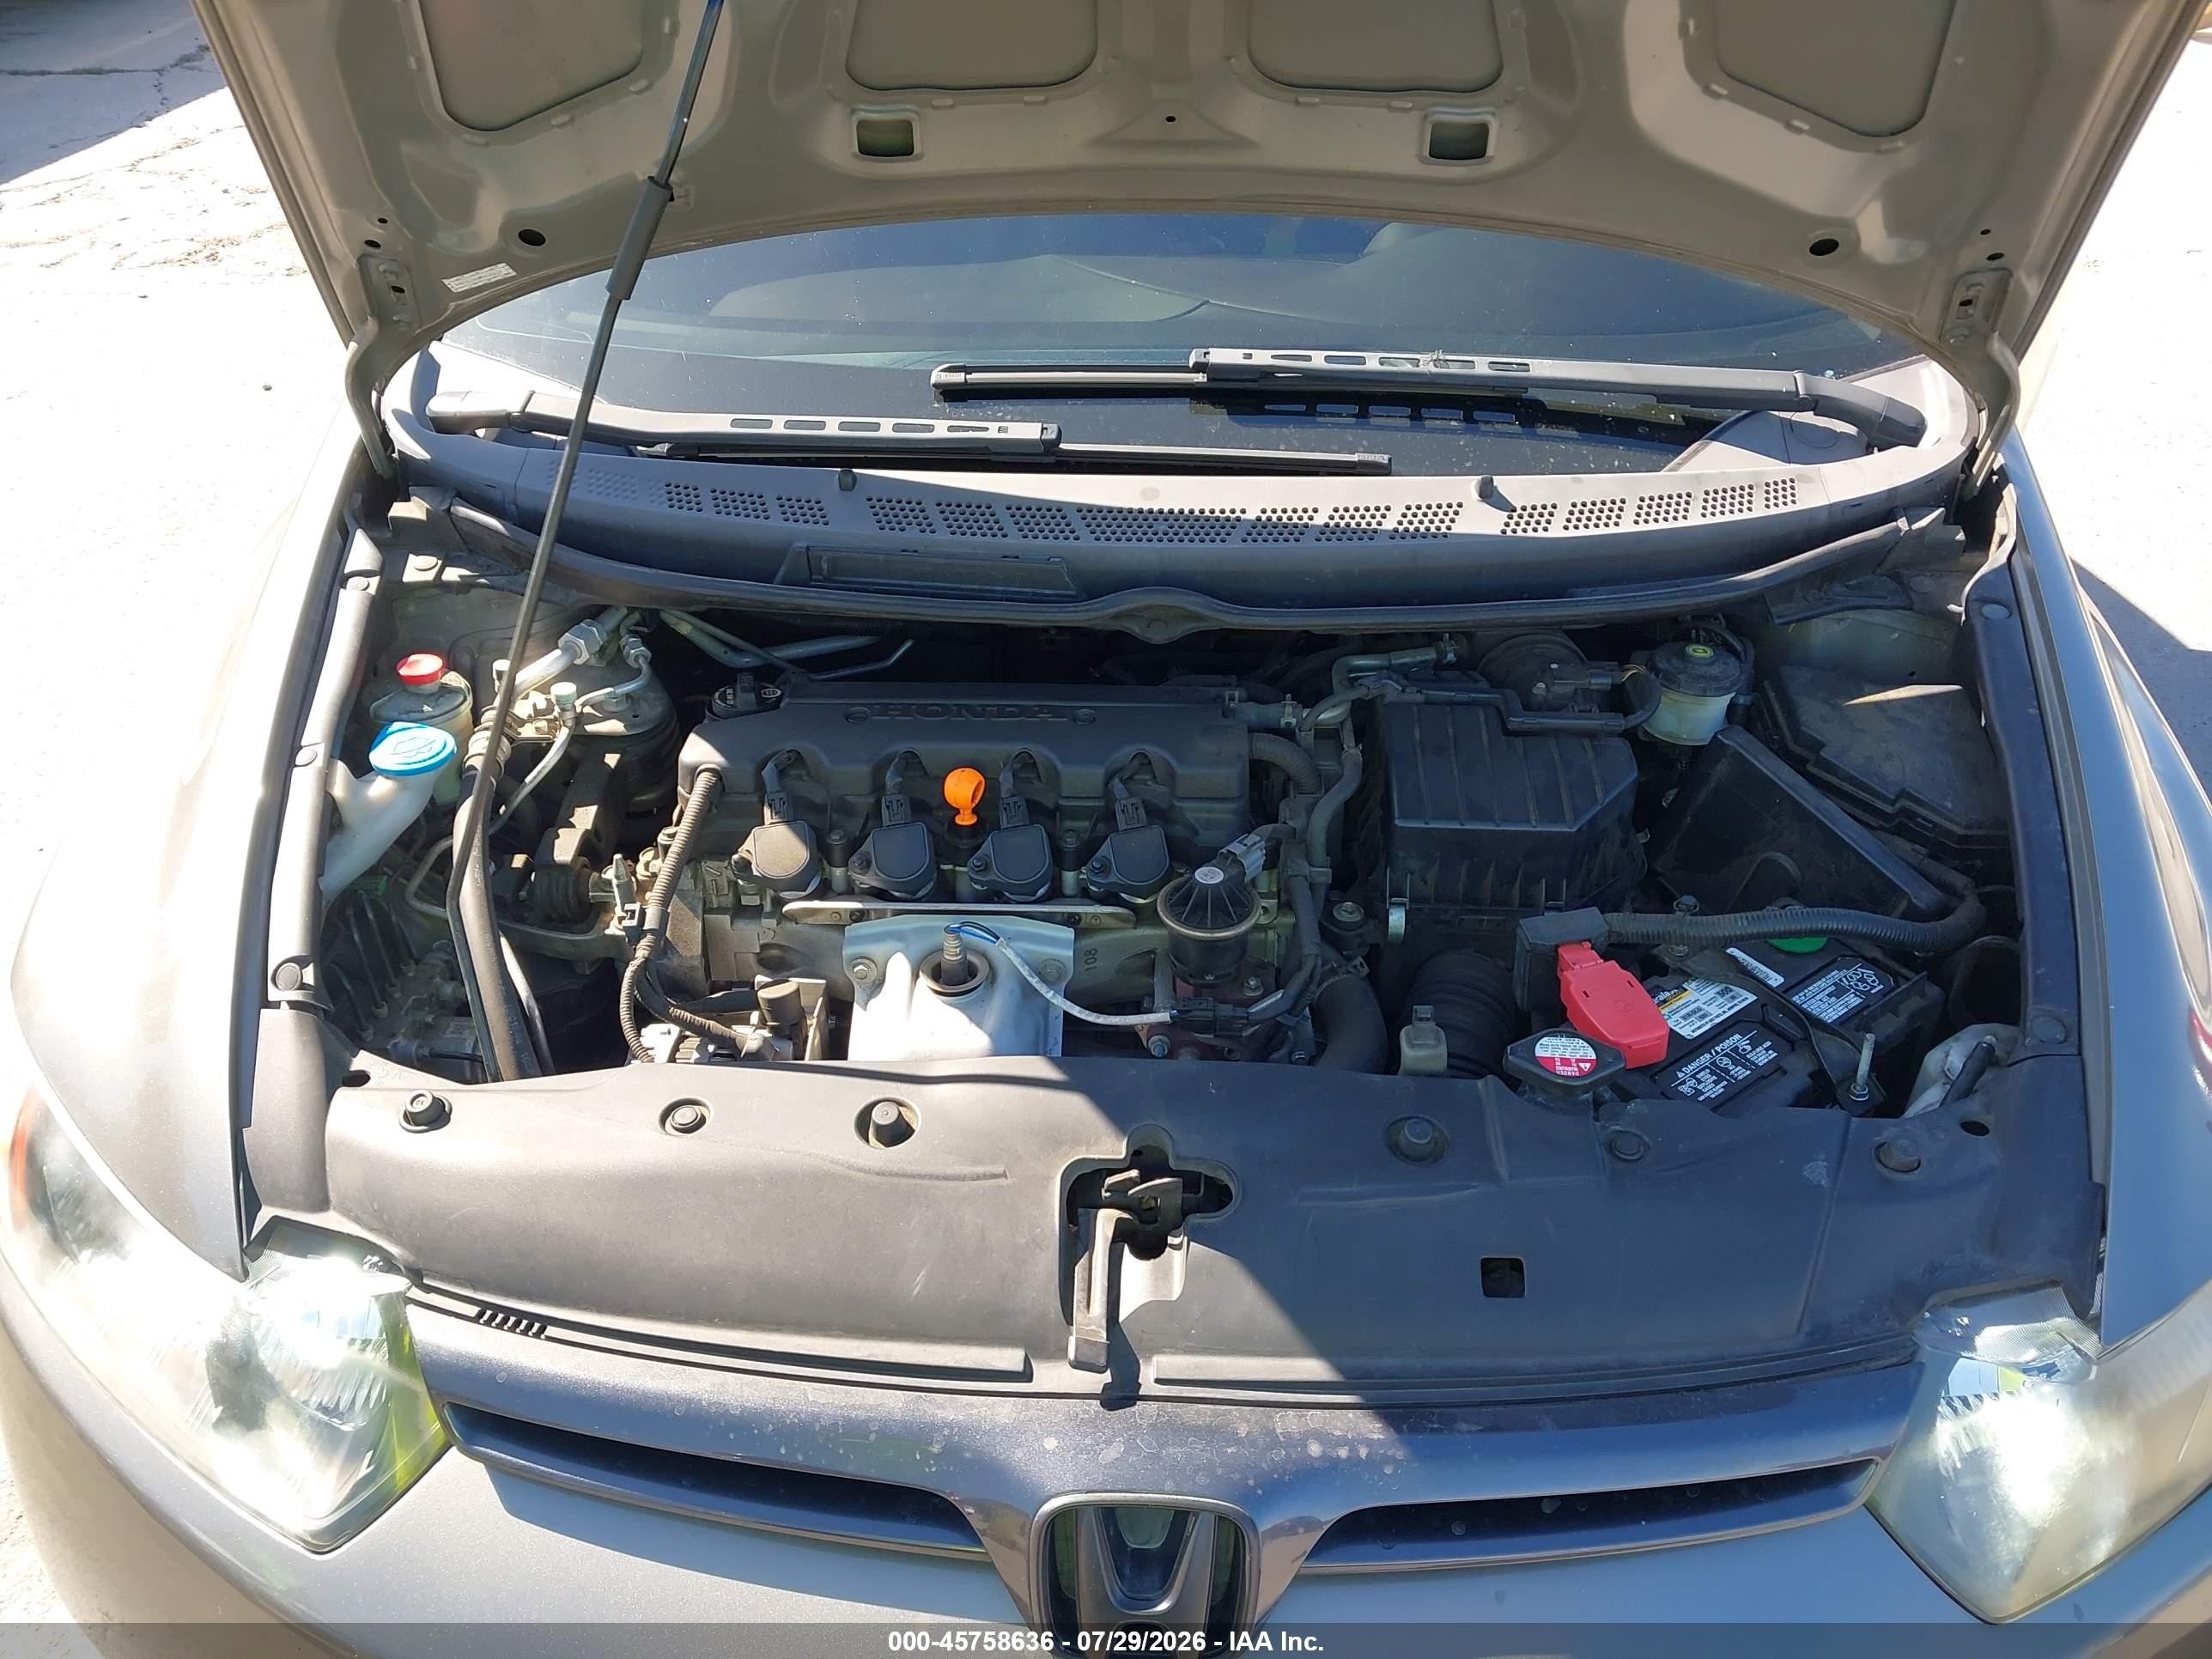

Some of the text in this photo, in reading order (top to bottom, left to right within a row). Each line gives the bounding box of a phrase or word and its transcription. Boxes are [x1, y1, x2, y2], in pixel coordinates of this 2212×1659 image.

[872, 704, 1068, 721] HONDA
[1084, 948, 1098, 971] 108
[1681, 1054, 1713, 1074] DANGER
[1714, 1033, 1743, 1053] POISON
